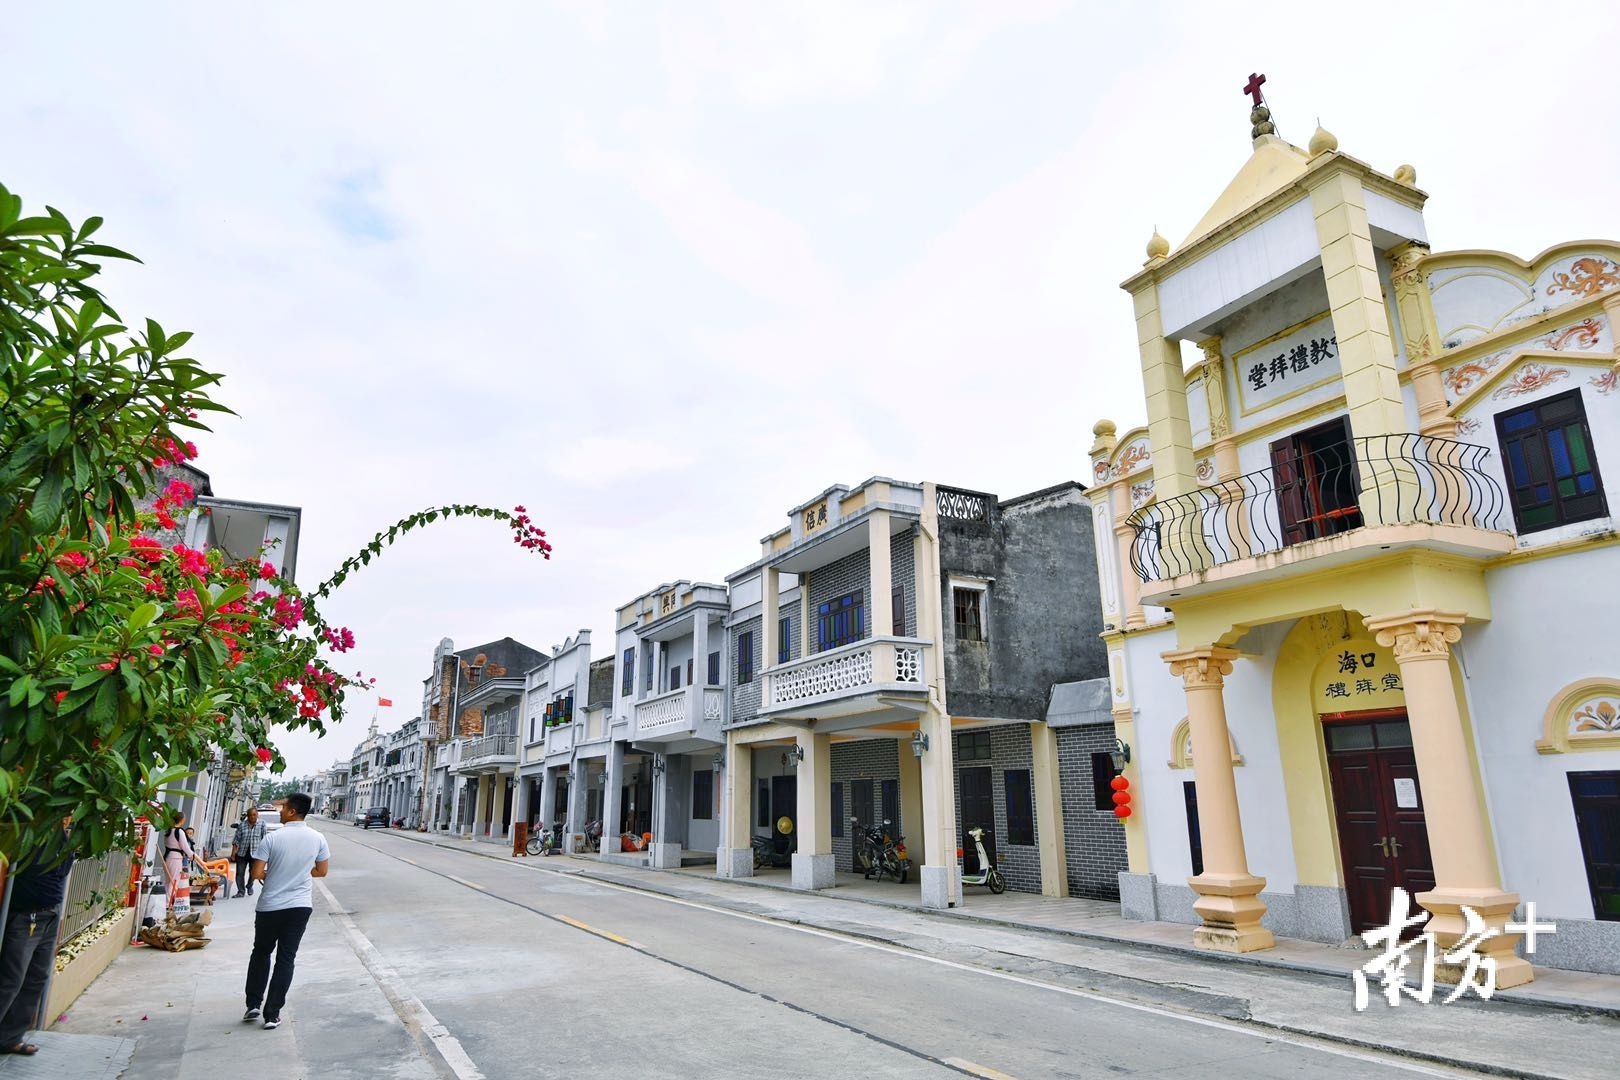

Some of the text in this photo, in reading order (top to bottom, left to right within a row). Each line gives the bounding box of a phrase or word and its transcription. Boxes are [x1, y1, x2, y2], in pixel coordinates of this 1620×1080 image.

[1248, 332, 1338, 391] 教禮拜堂
[1338, 650, 1375, 674] 海口
[1325, 673, 1404, 699] 禮拜堂
